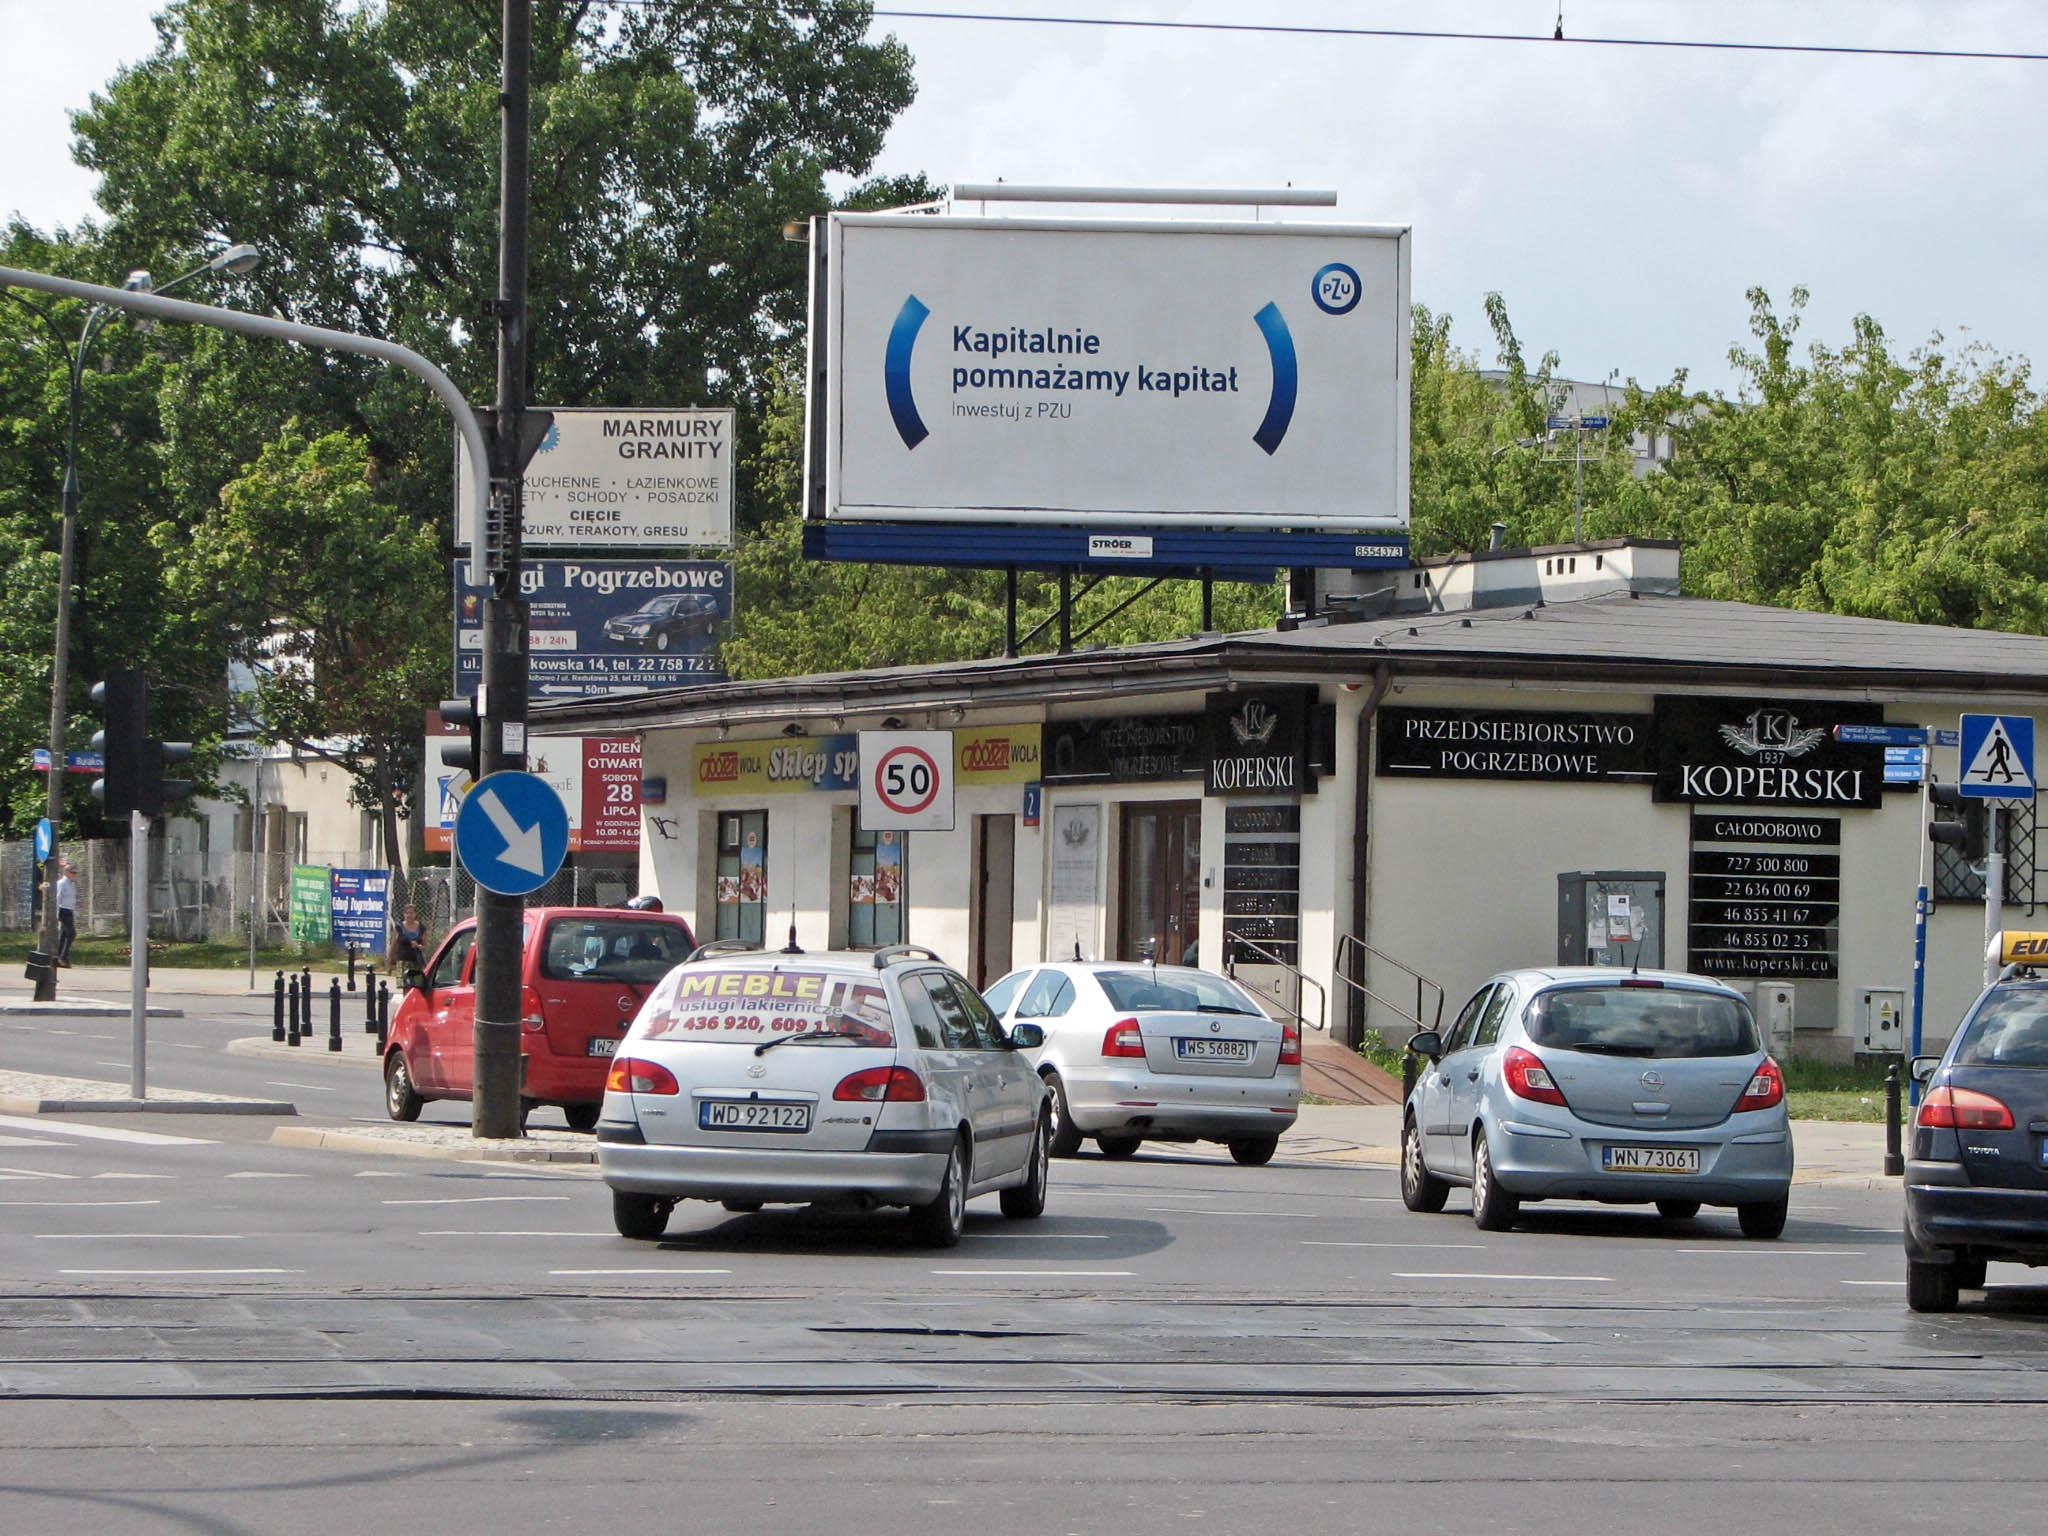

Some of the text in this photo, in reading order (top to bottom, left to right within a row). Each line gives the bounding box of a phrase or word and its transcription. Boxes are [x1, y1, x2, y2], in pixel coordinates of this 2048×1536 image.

[1323, 277, 1350, 300] PZU
[952, 325, 1100, 359] Kapitalnie
[952, 363, 1239, 397] pomnażamy kapitał
[952, 401, 1072, 422] Inwestuj z PZU
[602, 419, 724, 438] MARMURY
[618, 441, 723, 460] GRANITY
[626, 478, 719, 490] ŁAZIENKOWE
[567, 492, 628, 503] SCHODY
[648, 493, 719, 505] POSADZKI
[570, 510, 621, 523] CIĘCIE
[569, 526, 640, 539] TERAKOTY,
[643, 528, 689, 538] GRESU
[564, 564, 724, 594] Pogrzebowe
[463, 658, 480, 670] ul.
[589, 659, 608, 673] 14,
[613, 659, 634, 671] tel.
[638, 659, 657, 671] 22
[659, 659, 684, 671] 758
[585, 685, 607, 694] 50m
[1405, 719, 1634, 745] PRZEDSIĘBIORSTWO
[600, 740, 640, 753] DZIEŃ
[1011, 744, 1039, 762] WOLA
[588, 758, 642, 769] OTWART
[770, 747, 827, 783] Sklep
[1441, 751, 1598, 773] POGRZEBOWE
[1759, 752, 1784, 764] 1937
[887, 764, 930, 795] 50
[1213, 756, 1294, 789] KOPERSKI
[1680, 765, 1862, 800] KOPERSKI
[607, 784, 633, 802] 28
[603, 806, 637, 816] LIPCA
[1715, 822, 1821, 838] CAŁODOBOWO
[1727, 857, 1808, 872] 727 500 800
[1724, 882, 1810, 897] 22 636 00 69
[1724, 908, 1810, 922] 46 855 41 67
[1724, 933, 1809, 948] 46 855 02 25
[1703, 956, 1828, 974] www.koperski.eu
[680, 975, 818, 998] MEBLE
[680, 998, 843, 1018] usługi lakiernicze
[684, 1016, 719, 1031] 436
[724, 1015, 765, 1034] 920,
[771, 1017, 808, 1032] 609
[1187, 1042, 1245, 1055] WS 56882
[713, 1106, 806, 1127] WD 92122
[1615, 1151, 1696, 1168] WN 73061
